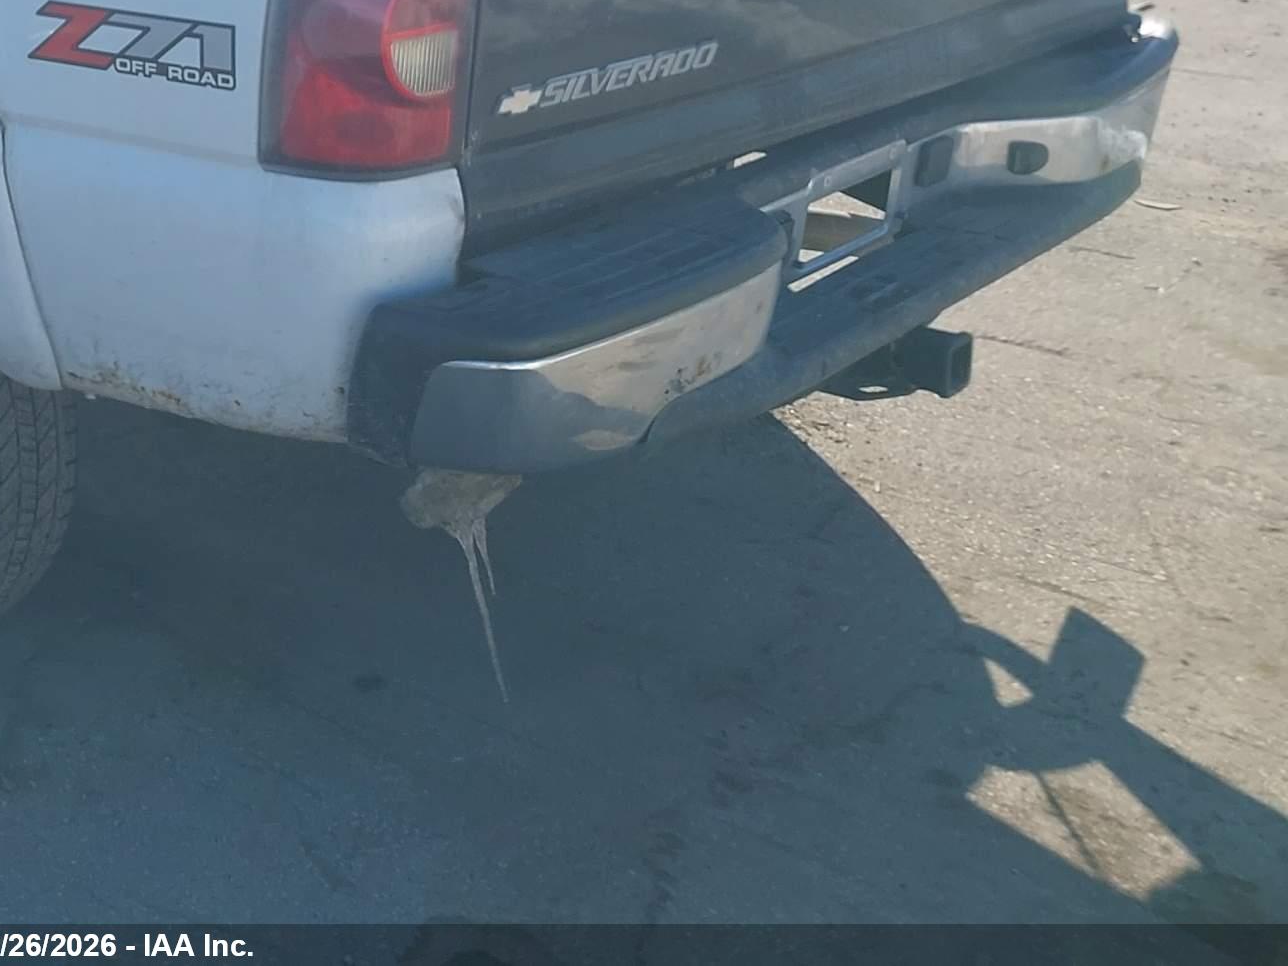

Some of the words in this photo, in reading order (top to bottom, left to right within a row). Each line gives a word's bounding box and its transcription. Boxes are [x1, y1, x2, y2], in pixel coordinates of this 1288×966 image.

[28, 0, 236, 74] Z71
[115, 58, 158, 77] OFF
[167, 65, 235, 89] ROAD
[539, 41, 719, 108] SILVERADO
